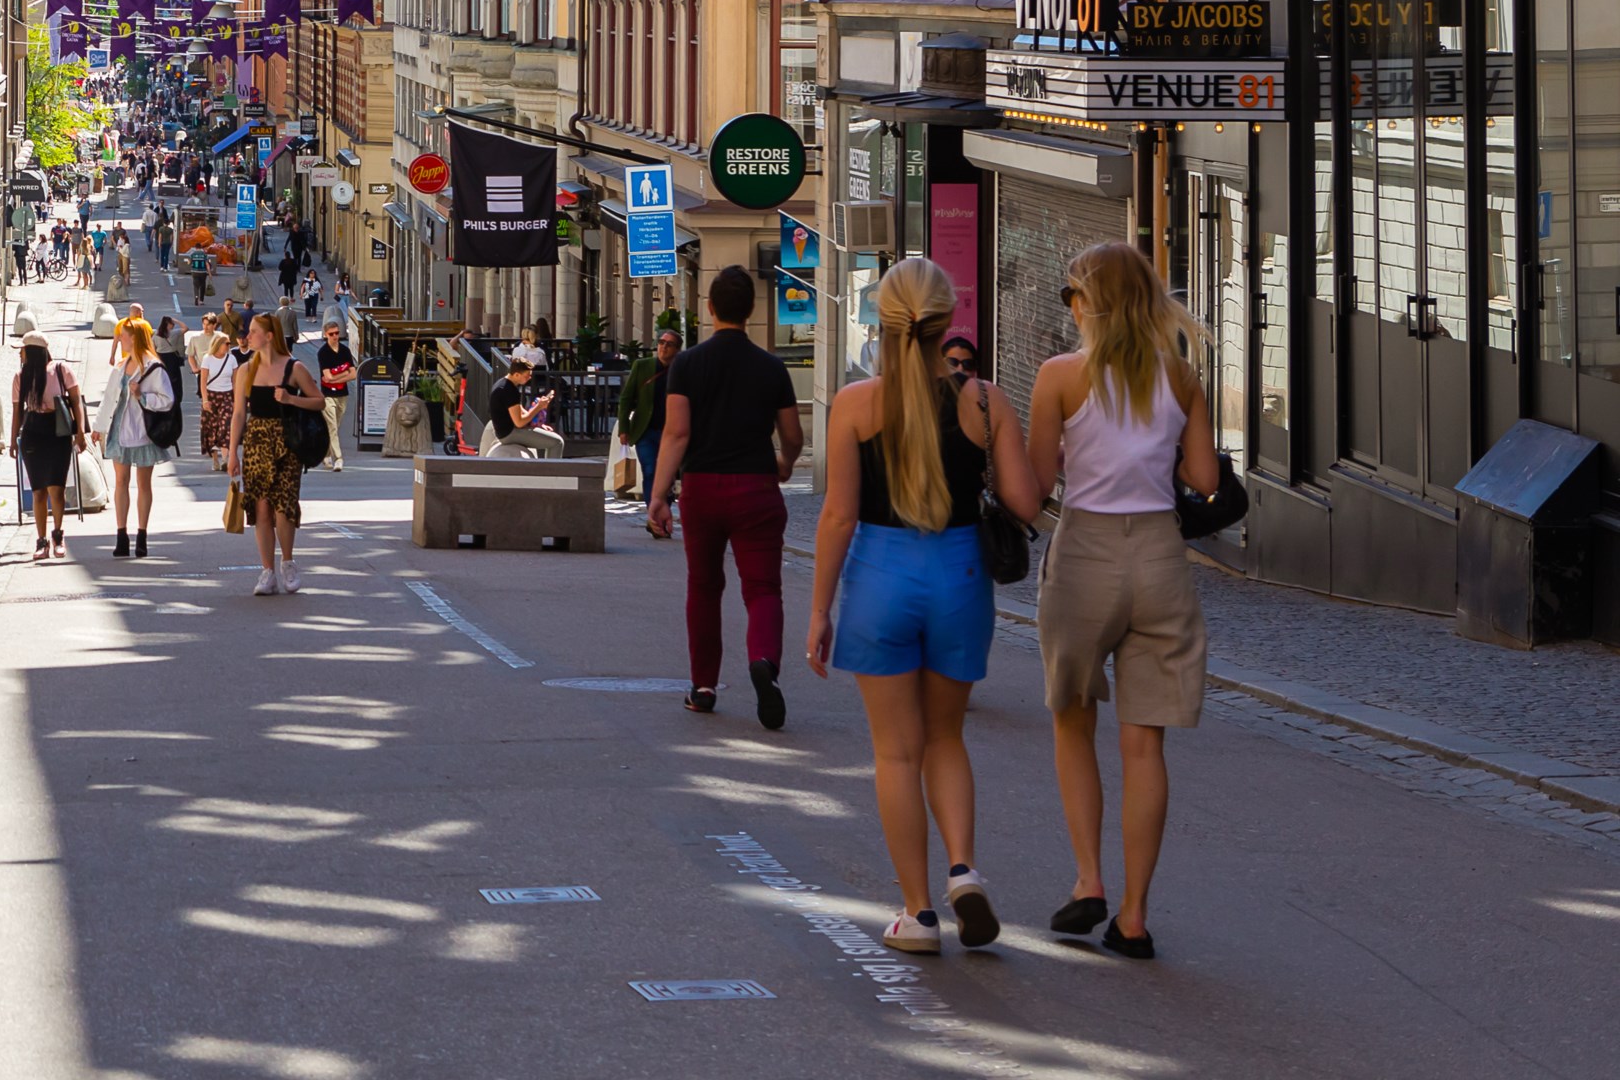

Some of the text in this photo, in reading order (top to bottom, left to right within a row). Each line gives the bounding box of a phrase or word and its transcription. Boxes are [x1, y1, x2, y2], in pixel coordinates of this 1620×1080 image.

[1133, 5, 1164, 28] BY
[1135, 33, 1263, 46] HAIR & BEAUTY
[1104, 74, 1275, 109] VENUE81
[250, 127, 273, 135] CARAT
[726, 148, 790, 161] RESTORE
[849, 147, 870, 172] RESTORE
[726, 163, 790, 175] GREENS
[463, 219, 497, 231] PHIL'S
[500, 219, 548, 231] BURGER
[759, 874, 821, 891] ger
[852, 964, 923, 984] sig
